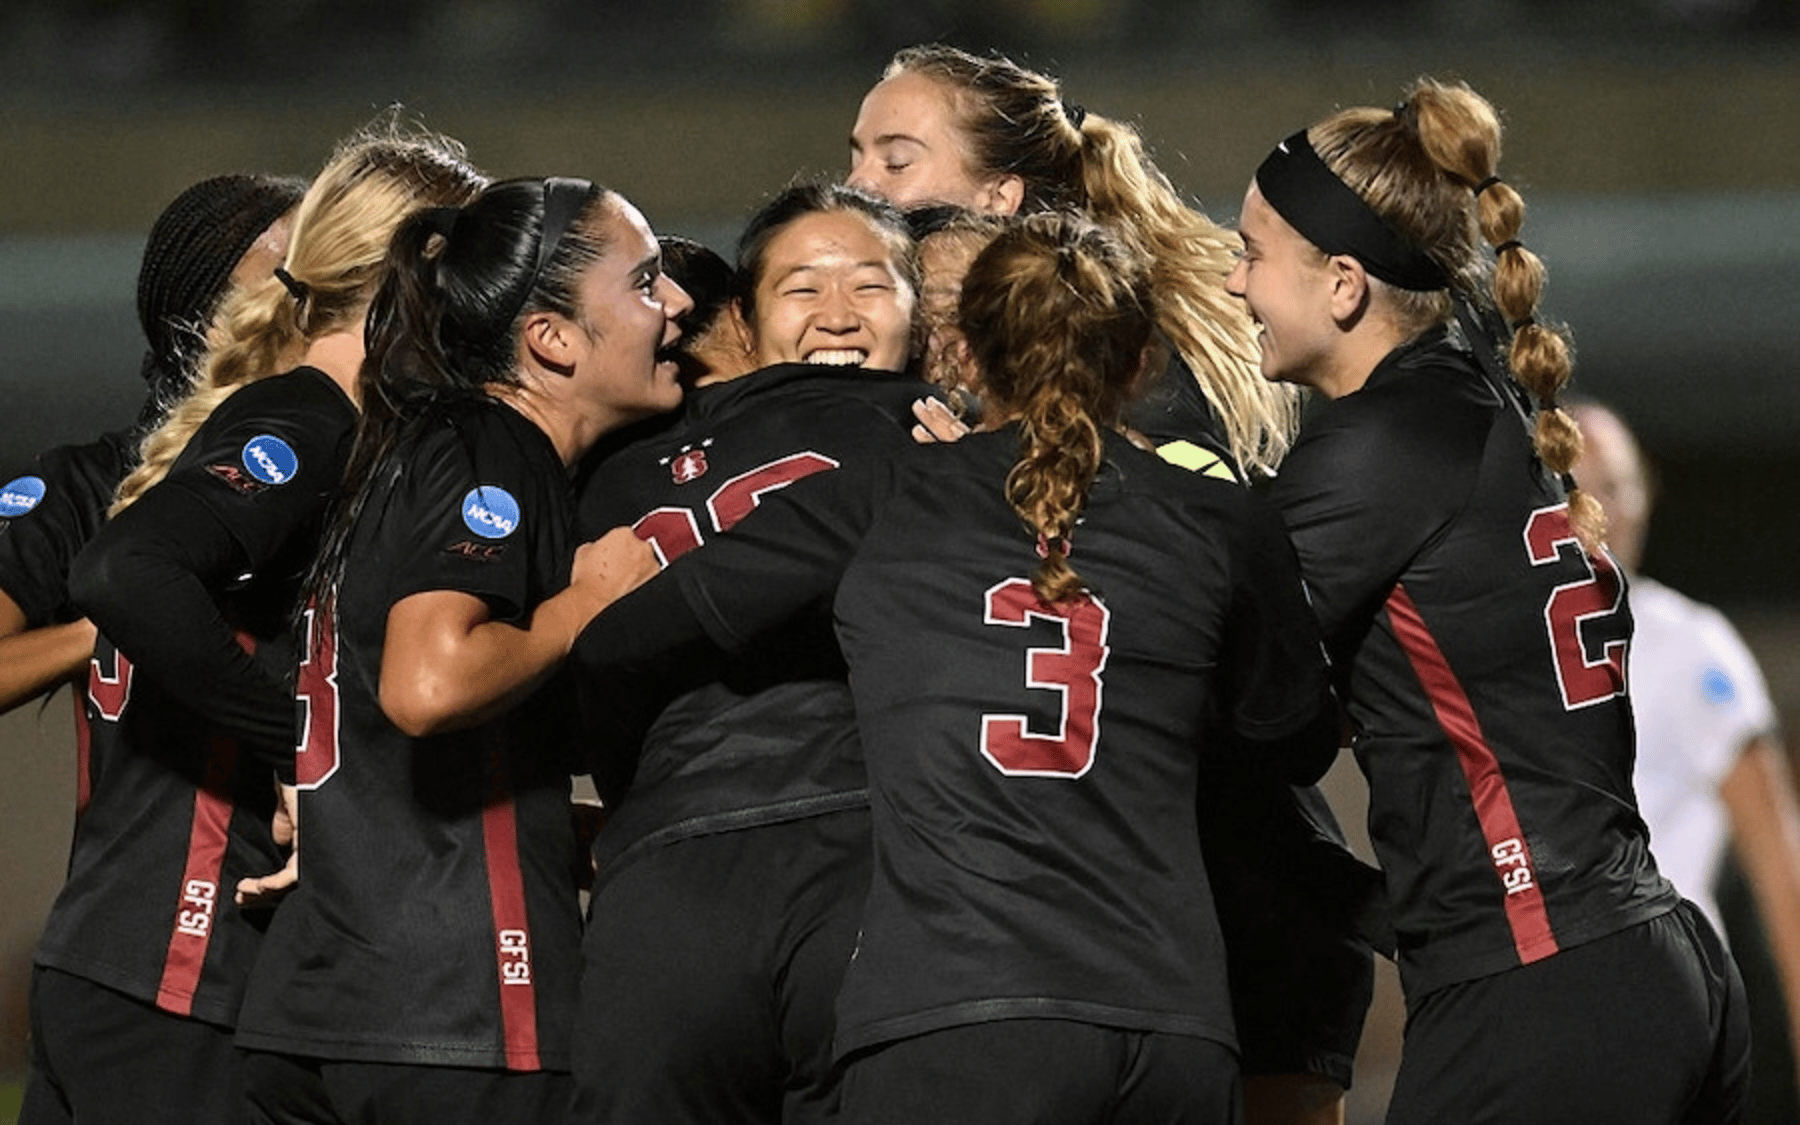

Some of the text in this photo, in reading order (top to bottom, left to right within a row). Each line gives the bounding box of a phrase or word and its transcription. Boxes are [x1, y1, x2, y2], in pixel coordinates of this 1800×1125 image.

[249, 445, 285, 483] NCAA
[467, 503, 512, 535] NCAA
[1523, 502, 1628, 711] 2
[981, 577, 1110, 779] 3
[1491, 838, 1534, 895] GFSI
[177, 879, 216, 937] GFSI
[499, 928, 531, 985] GFSI
